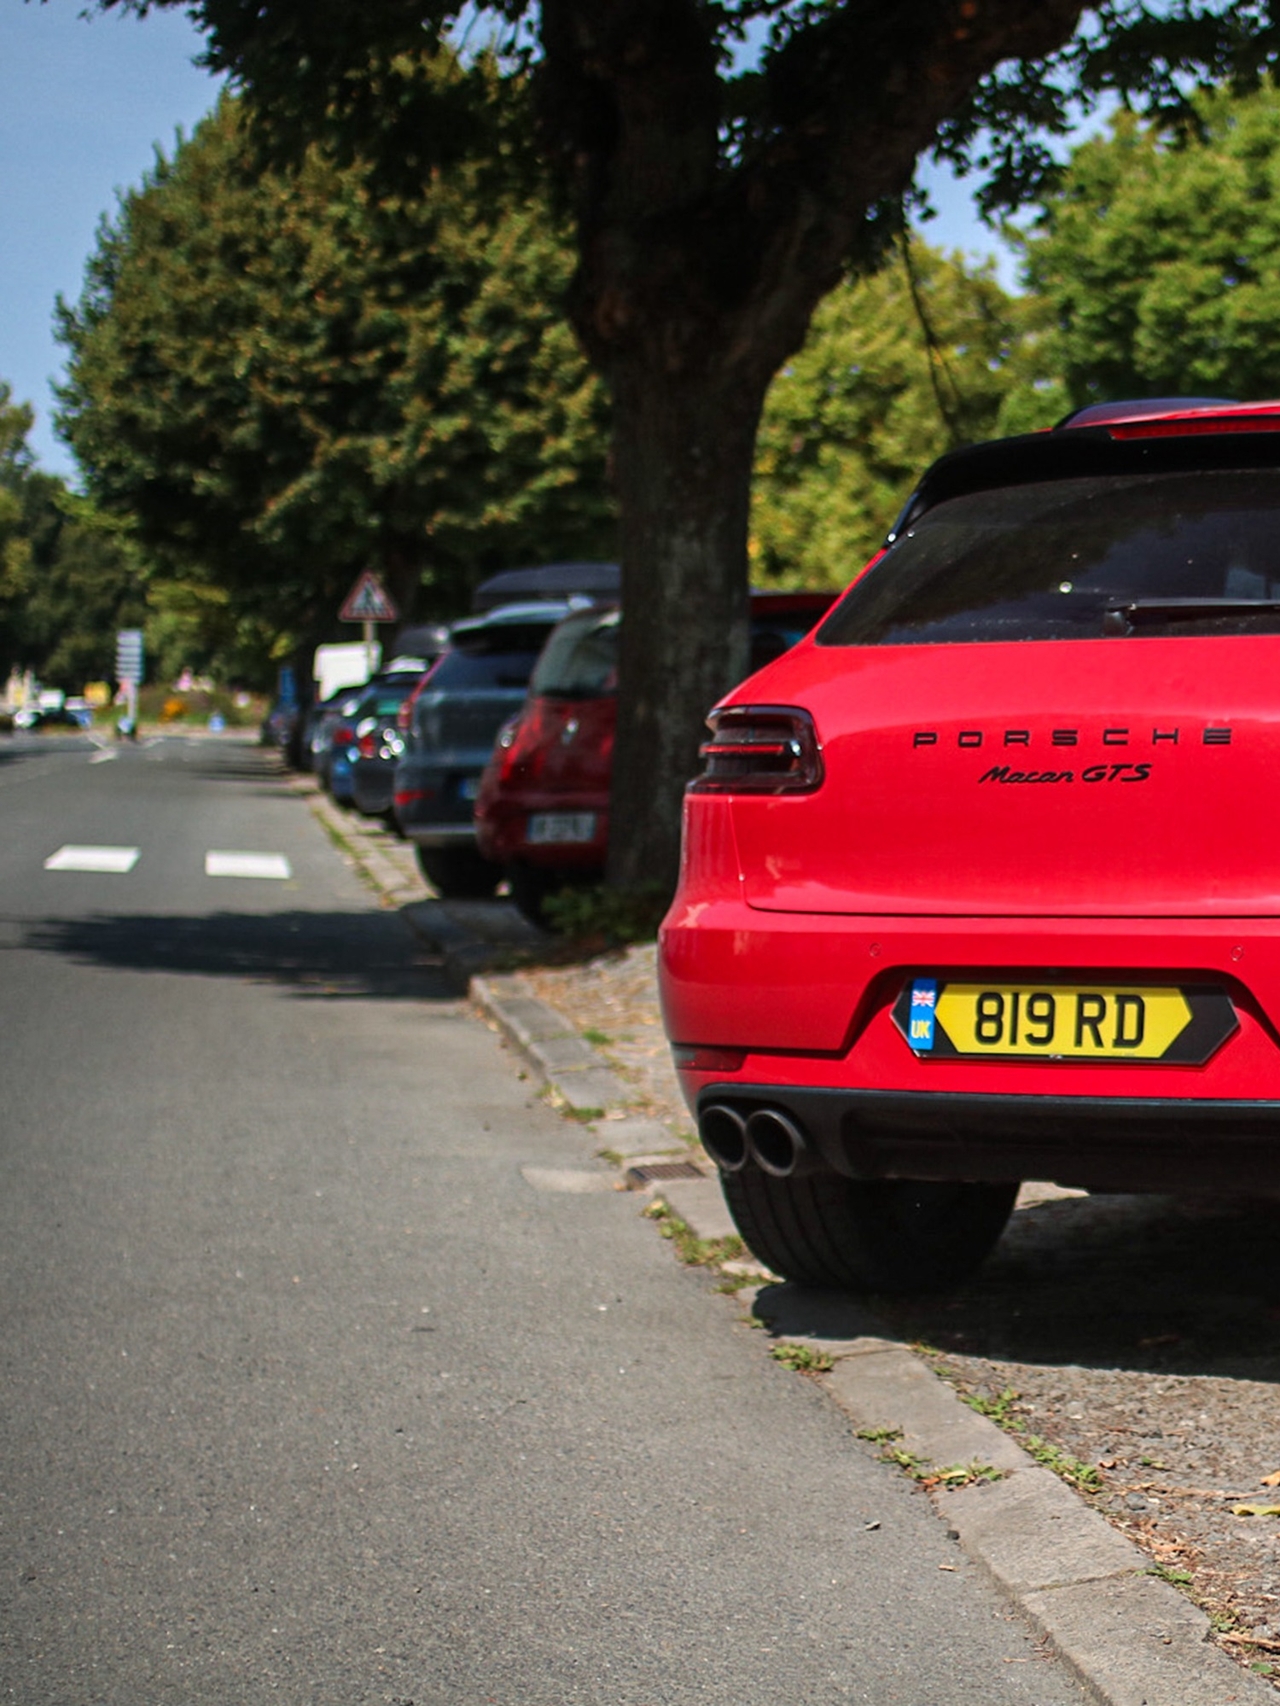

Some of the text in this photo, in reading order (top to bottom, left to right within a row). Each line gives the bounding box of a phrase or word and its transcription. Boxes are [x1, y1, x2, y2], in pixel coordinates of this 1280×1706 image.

[912, 727, 1233, 749] PORSCHE
[978, 763, 1153, 784] Macan GTS
[911, 1020, 932, 1039] UK
[974, 991, 1145, 1048] 819 RD
